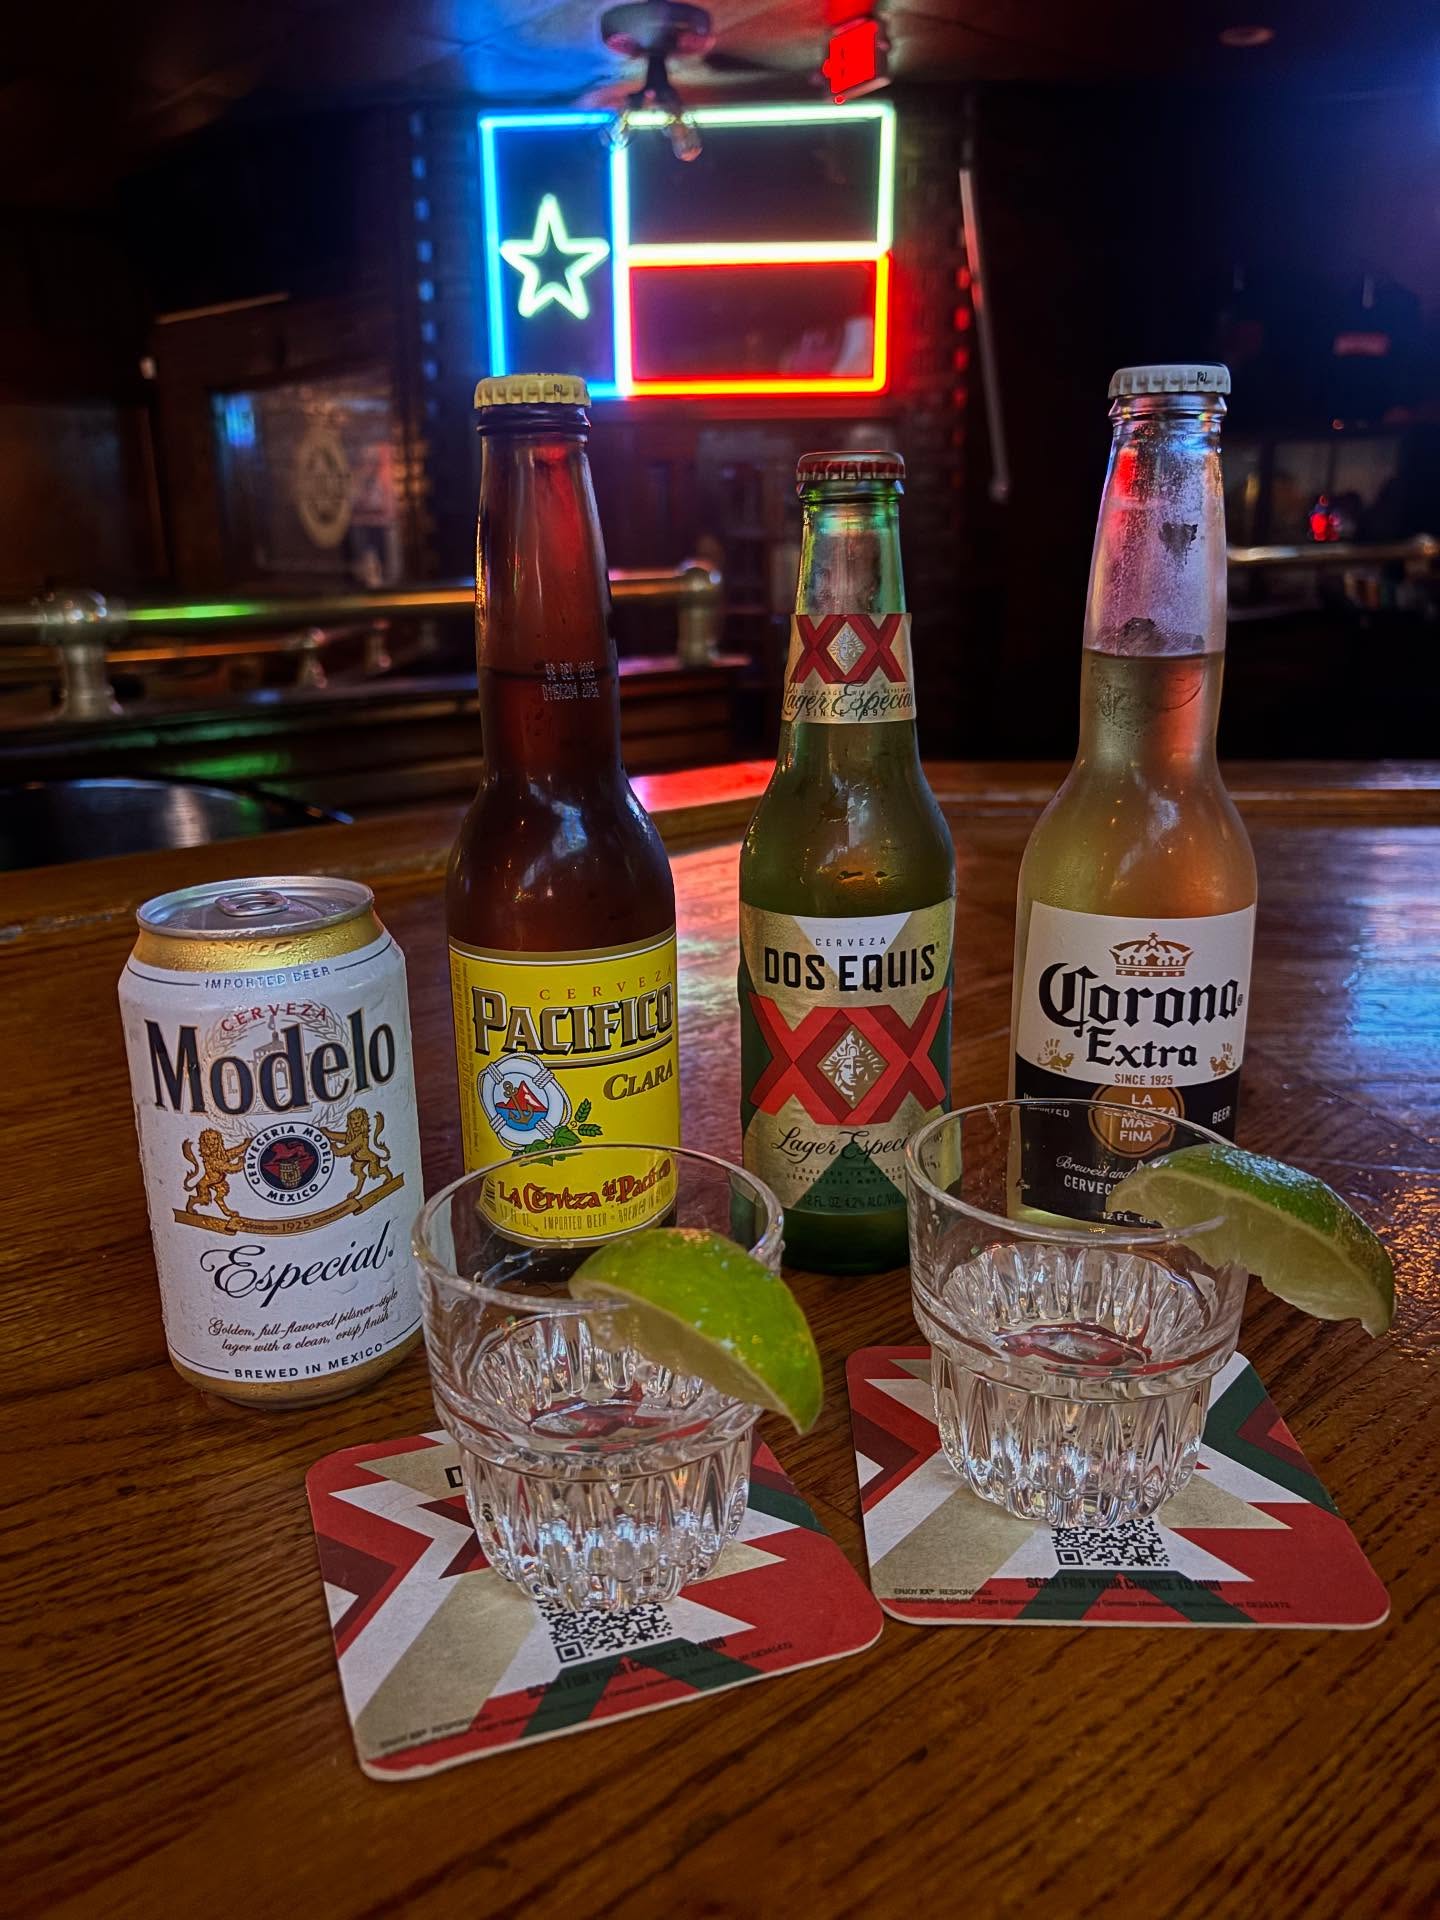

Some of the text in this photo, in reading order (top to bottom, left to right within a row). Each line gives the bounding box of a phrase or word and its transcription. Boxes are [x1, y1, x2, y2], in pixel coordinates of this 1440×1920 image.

[815, 936, 886, 947] CERVEZA
[205, 966, 331, 989] IMPORTED BEER
[764, 943, 936, 993] DOS EQUIS
[538, 967, 672, 1001] CERVEZA
[1038, 962, 1241, 1038] Corona
[221, 1002, 327, 1032] CERVEZA
[471, 981, 674, 1055] PACIFICO
[143, 1007, 396, 1116] Modelo
[1086, 1026, 1198, 1068] Extra
[603, 1058, 674, 1101] CLARA
[1114, 1073, 1173, 1085] SINCE 1925
[1131, 1093, 1153, 1105] LA
[1212, 1106, 1231, 1124] BEER
[771, 1126, 910, 1165] Lager Especi
[1119, 1130, 1153, 1141] FINA
[247, 1125, 332, 1185] CERVECERIA MODELO
[1056, 1155, 1111, 1177] Brewed
[266, 1183, 319, 1202] MEXICO
[523, 1182, 602, 1213] Cerveza
[1064, 1174, 1116, 1195] CERVEC
[281, 1220, 311, 1232] 1925
[543, 1215, 582, 1231] IMPORTED
[586, 1213, 607, 1229] BEER
[1102, 1212, 1113, 1220] 12
[208, 1289, 398, 1340] Golden, full-flavored pilsner-style
[221, 1311, 390, 1357] lager with a clean, crisp finish
[235, 1342, 383, 1379] BREWED IN MEXICO
